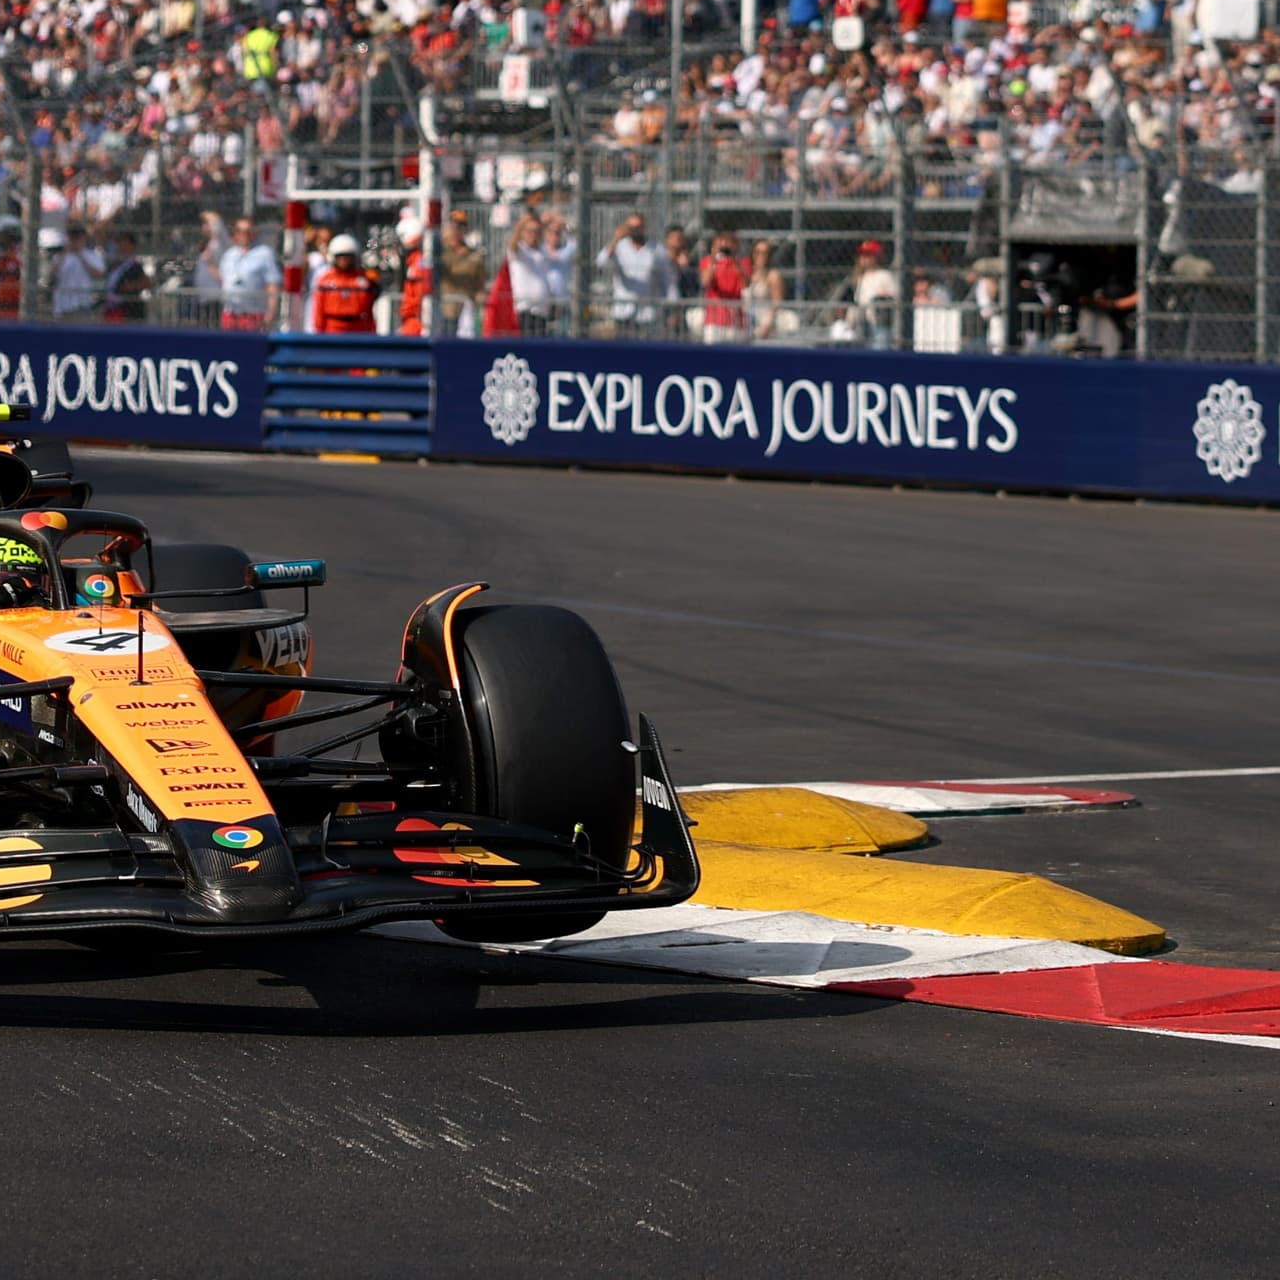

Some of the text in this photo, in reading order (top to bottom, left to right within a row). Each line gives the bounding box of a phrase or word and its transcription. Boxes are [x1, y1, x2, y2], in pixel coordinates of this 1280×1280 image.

[42, 353, 239, 422] JOURNEYS
[548, 371, 1018, 457] EXPLORA JOURNEYS
[268, 564, 313, 578] allwyn
[65, 631, 139, 652] 4
[2, 641, 26, 666] MILLE
[116, 701, 196, 710] allwyn
[125, 719, 208, 728] webex
[159, 766, 237, 776] FxPro
